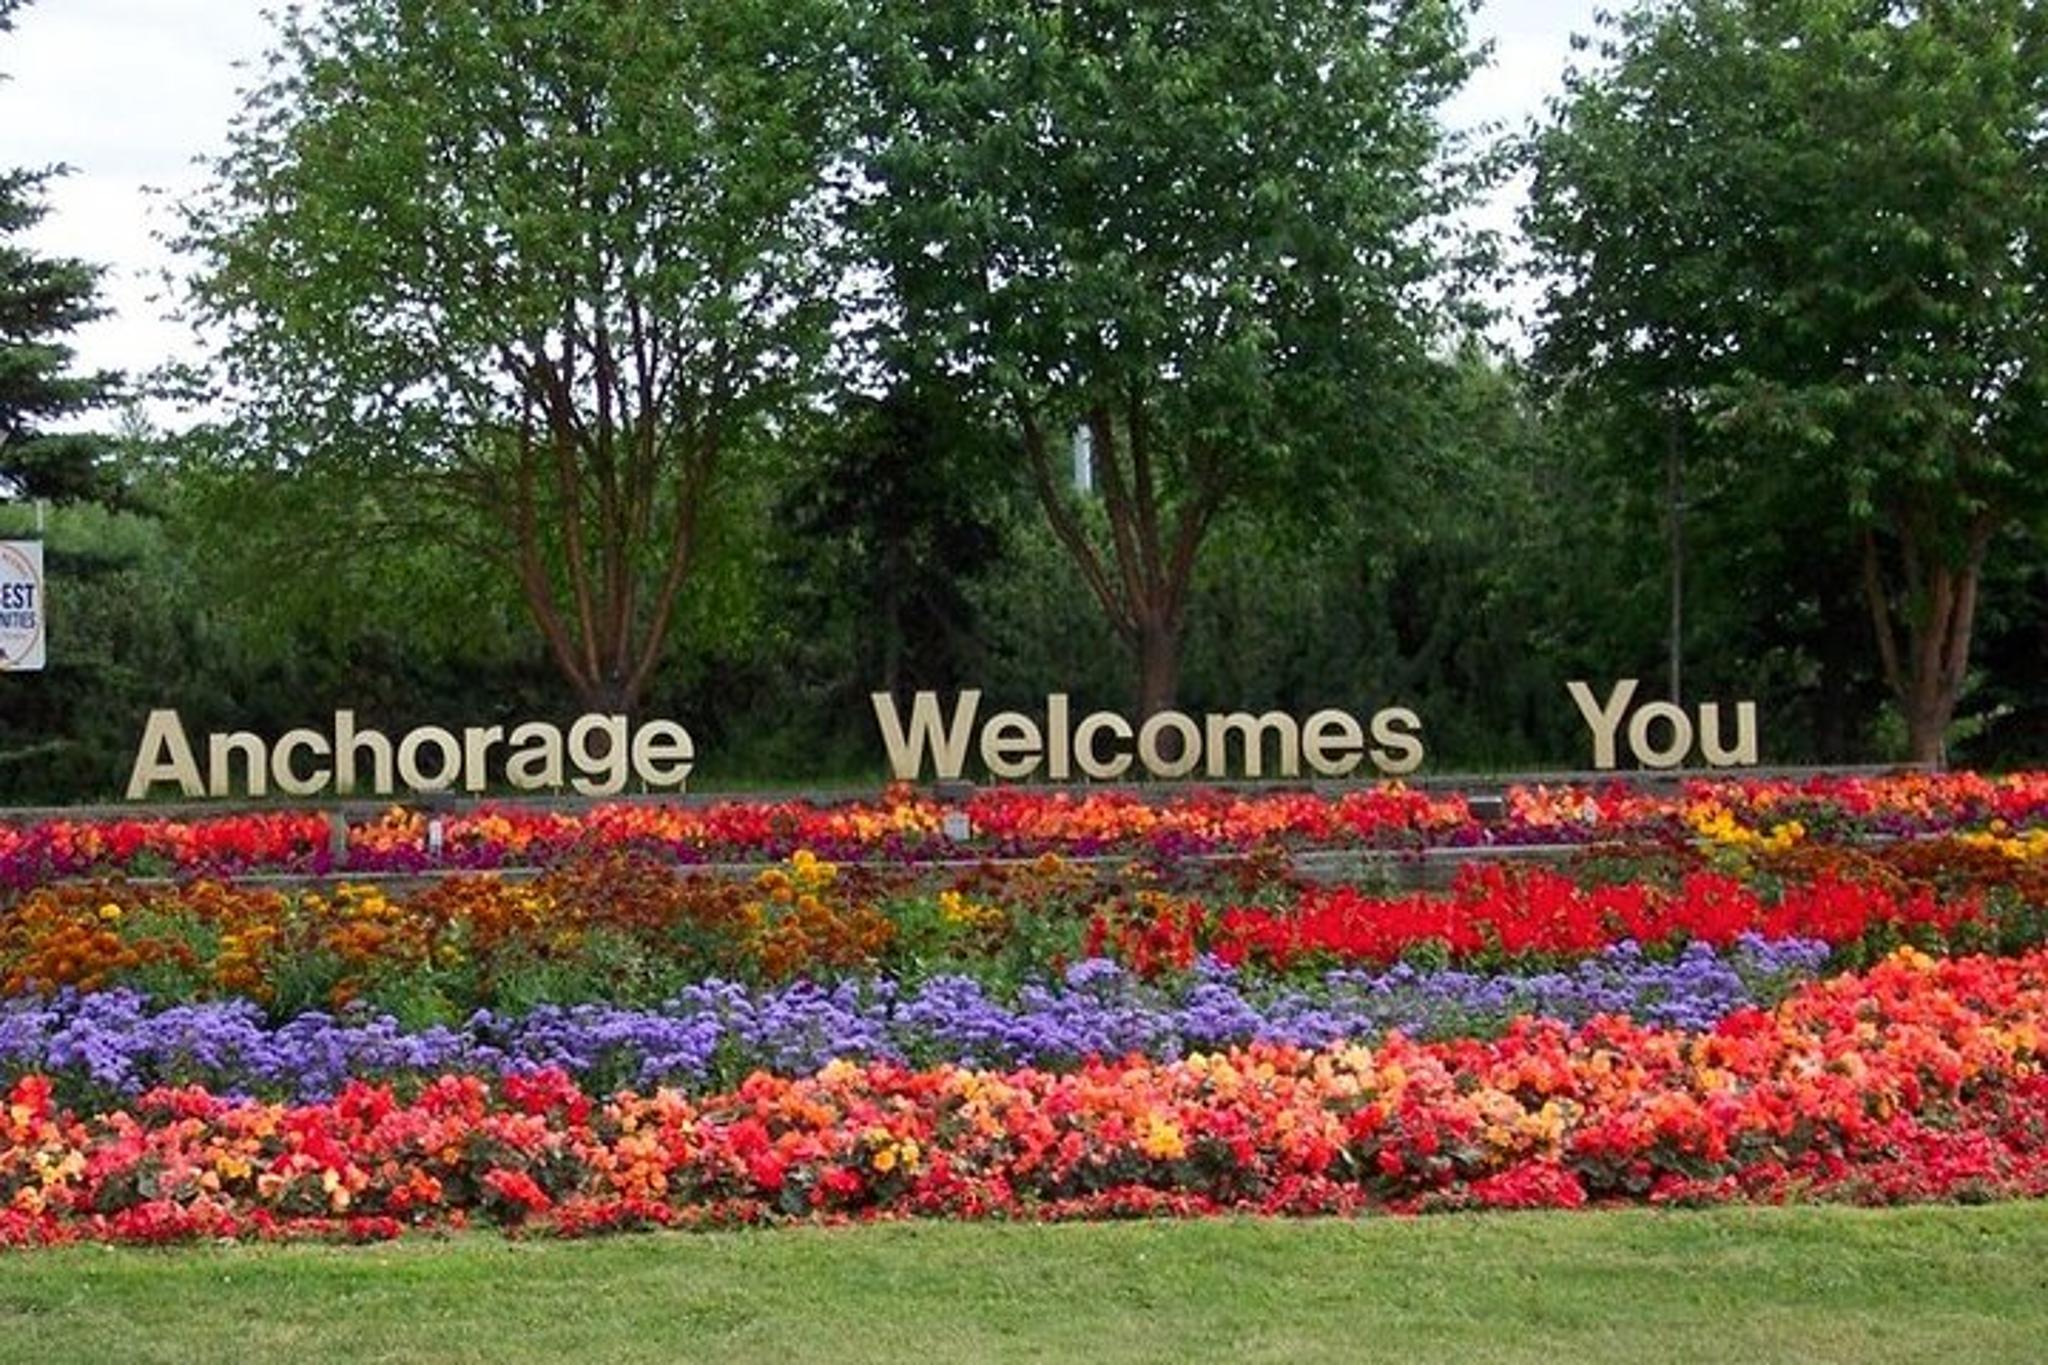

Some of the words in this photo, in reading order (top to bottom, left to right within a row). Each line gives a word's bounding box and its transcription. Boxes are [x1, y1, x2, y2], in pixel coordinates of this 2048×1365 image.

[2, 582, 35, 609] EST
[126, 709, 695, 799] Anchorage
[871, 689, 1424, 779] Welcomes
[1566, 679, 1758, 769] You
